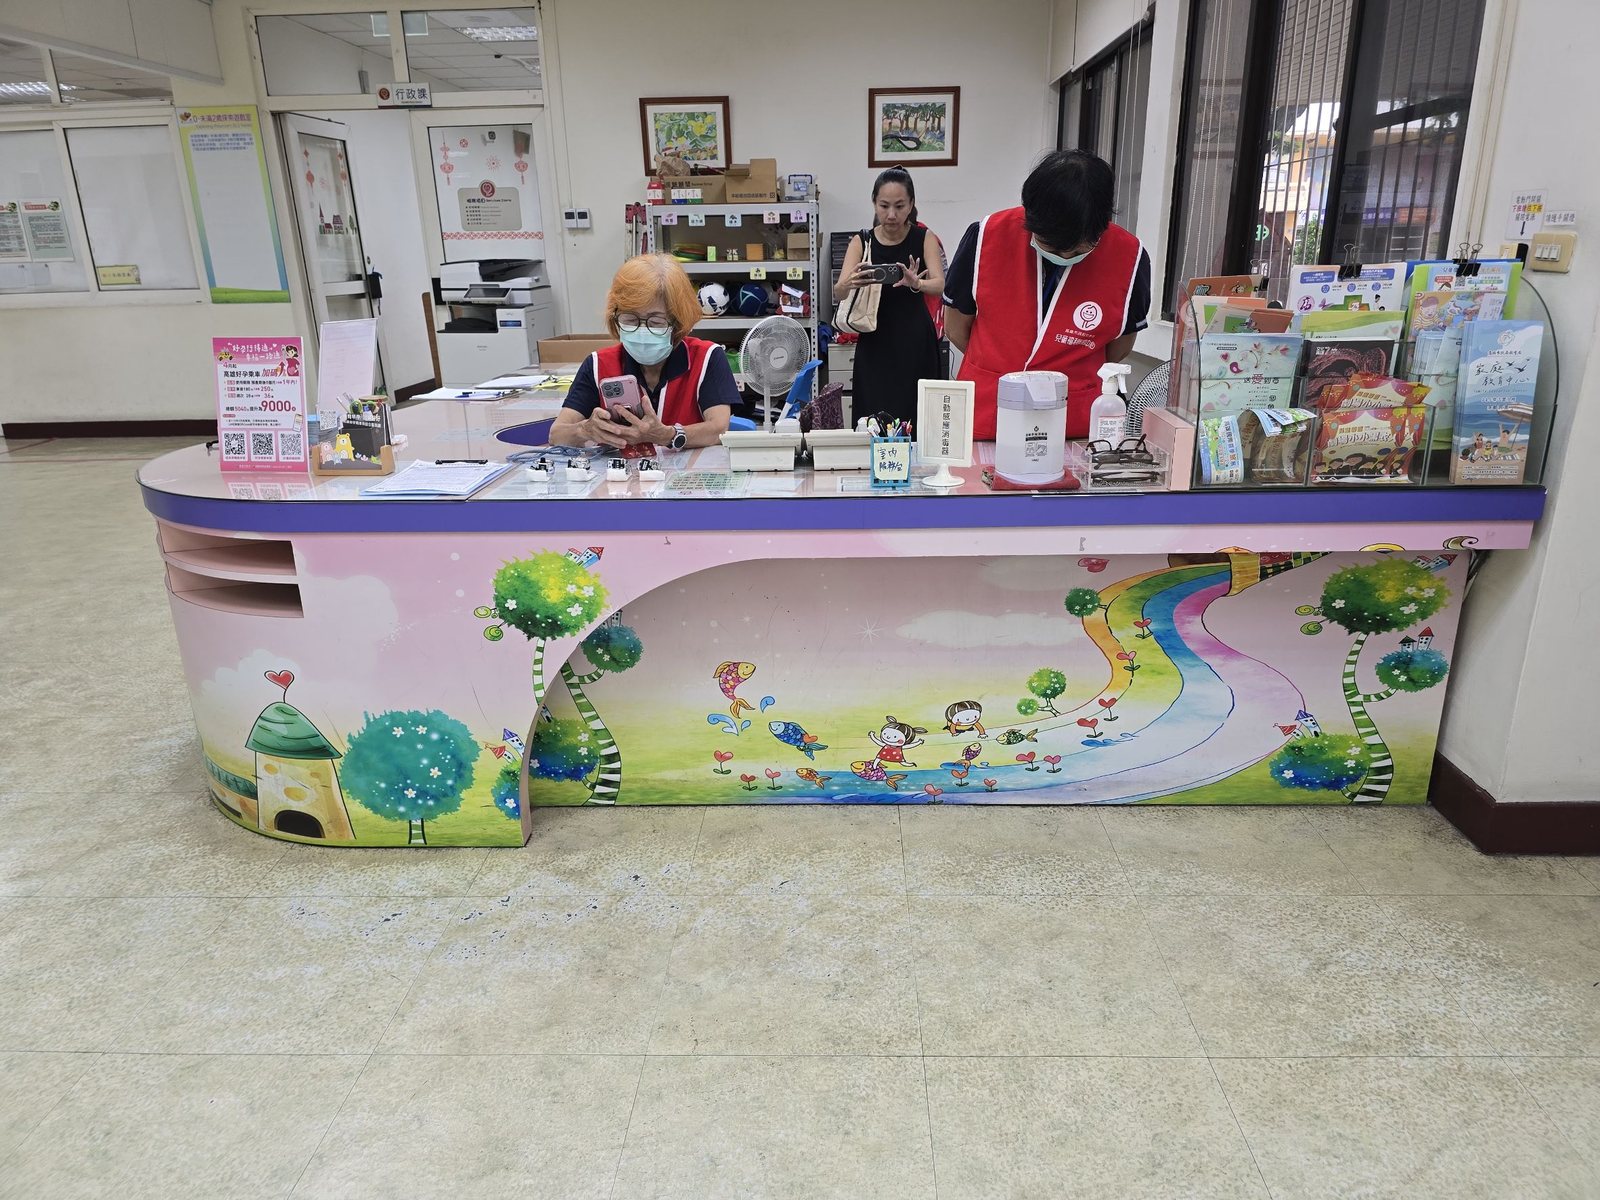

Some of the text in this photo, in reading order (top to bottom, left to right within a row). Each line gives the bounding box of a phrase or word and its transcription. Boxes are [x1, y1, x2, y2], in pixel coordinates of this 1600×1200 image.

[395, 87, 428, 100] 行政課
[223, 370, 260, 378] 高雄好孕乘車
[1475, 361, 1504, 377] 家庭
[1482, 376, 1530, 387] 教育中心
[941, 395, 951, 456] 自動感應消毒器
[878, 447, 897, 460] 室內
